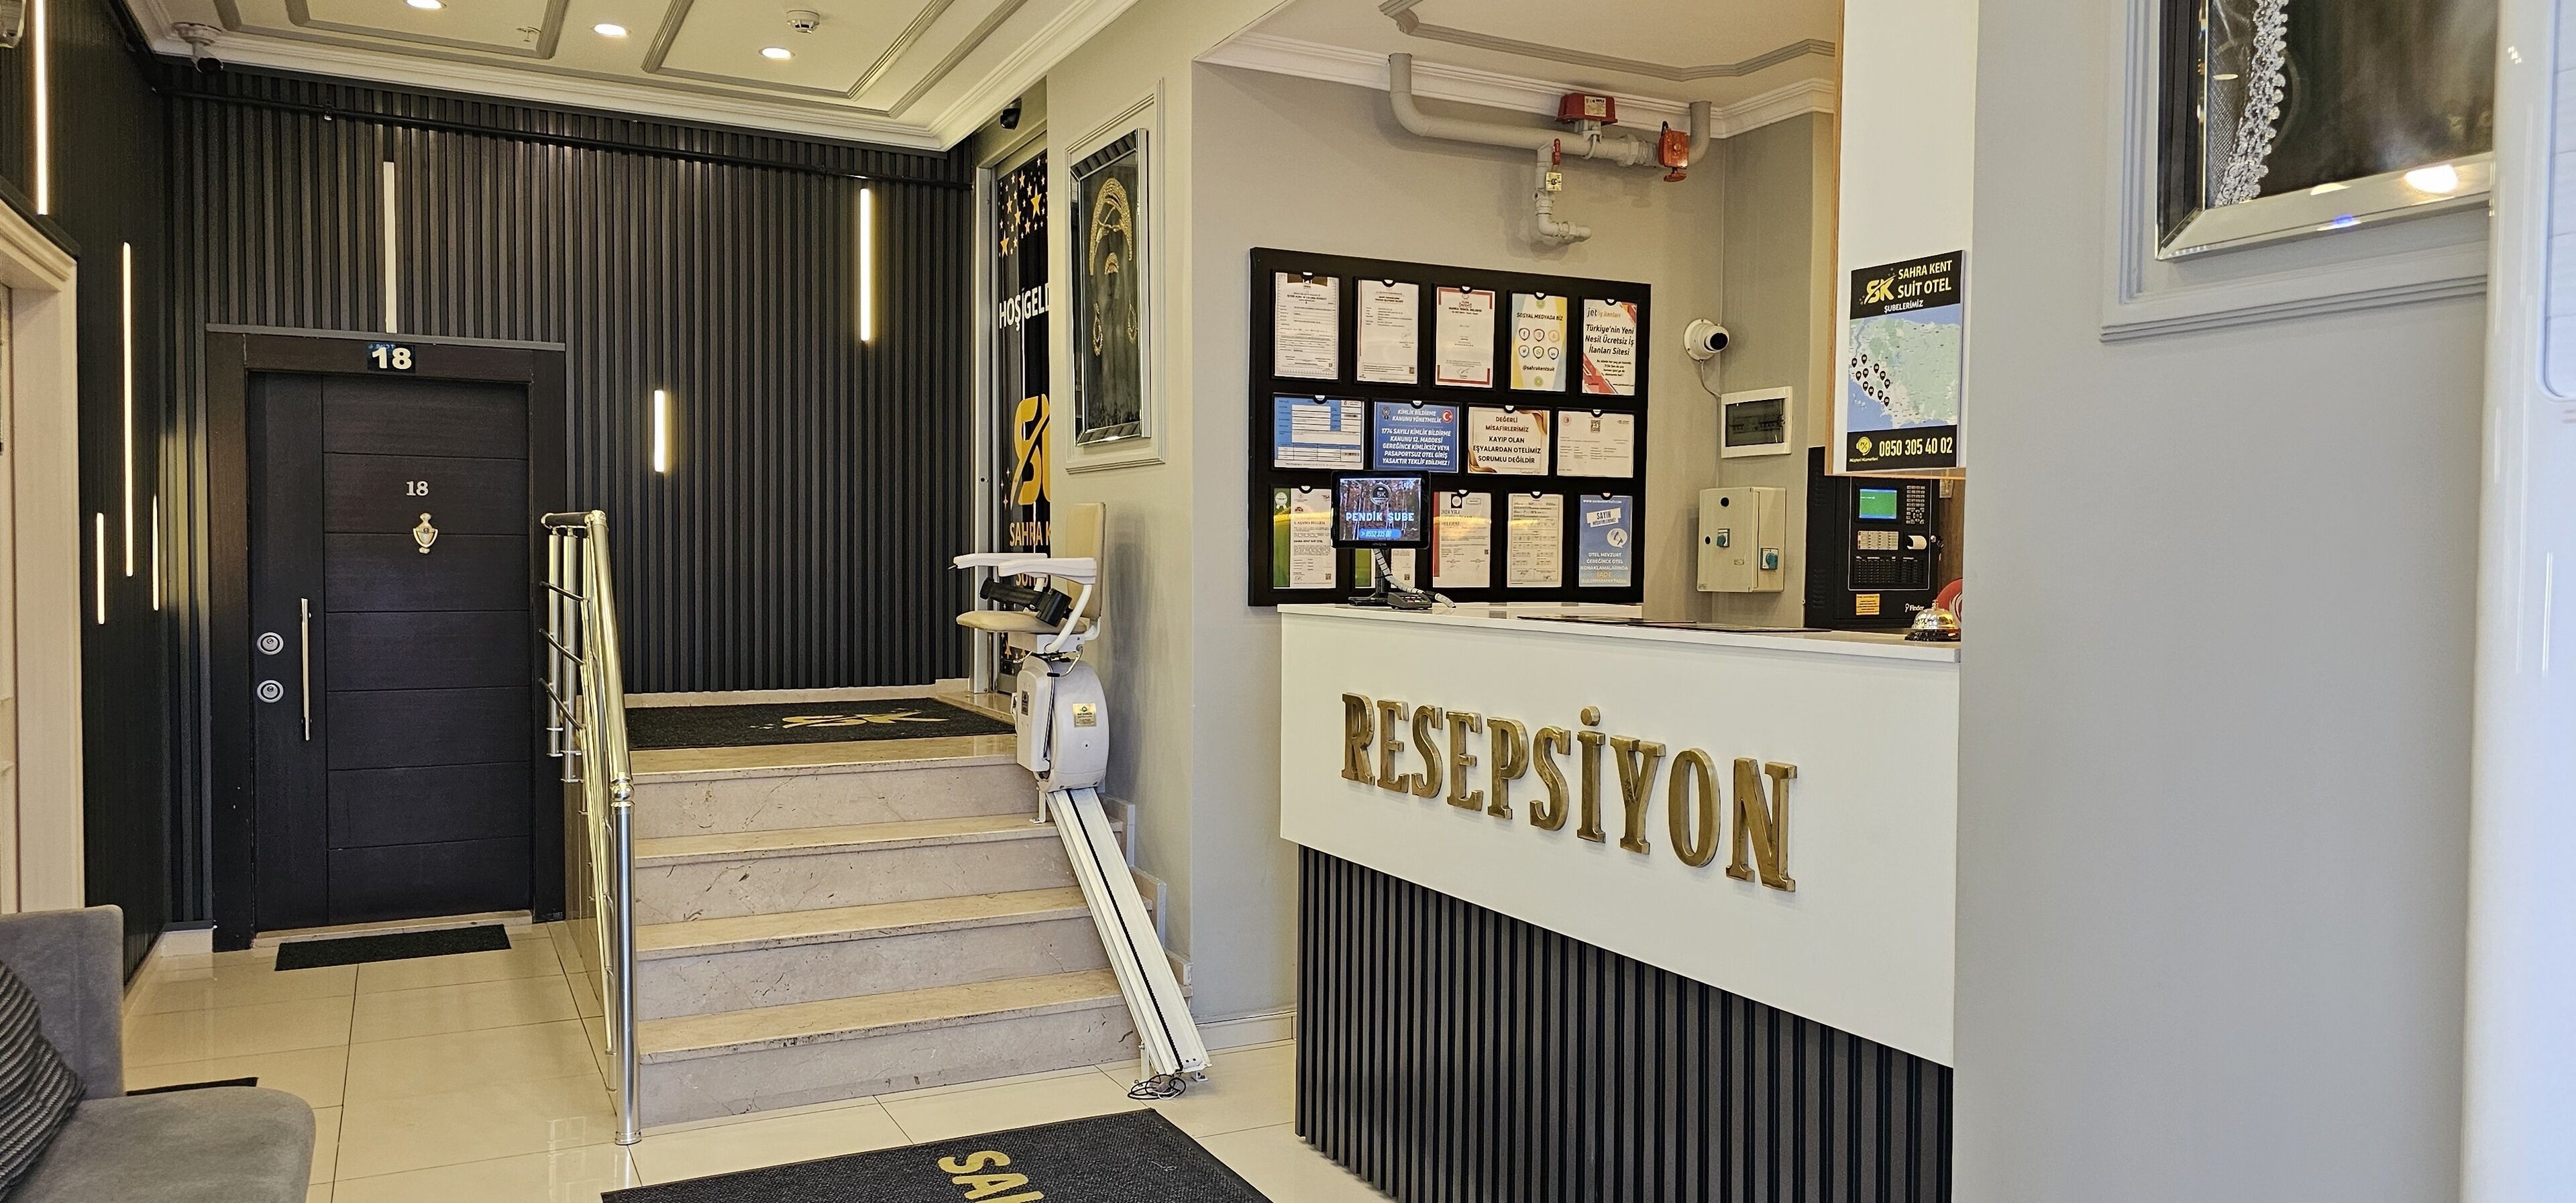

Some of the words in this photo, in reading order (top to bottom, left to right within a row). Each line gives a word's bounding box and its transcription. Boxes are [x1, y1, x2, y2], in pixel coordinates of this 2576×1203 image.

[1898, 265, 1927, 280] SAHRA
[1929, 260, 1953, 274] KENT
[1864, 275, 1896, 305] SK
[1898, 280, 1922, 299] SUİT
[1924, 277, 1951, 294] OTEL
[1587, 307, 1597, 317] jet
[1884, 299, 1924, 313] ŞUBELERİMİZ
[1587, 324, 1620, 334] Türkiye'nin
[1585, 335, 1601, 343] Nesil
[1603, 335, 1627, 345] Ücretsiz
[1629, 335, 1634, 347] İş
[1589, 344, 1611, 354] İlanları
[1613, 348, 1630, 356] Sitesi
[372, 348, 412, 369] 18
[1485, 424, 1529, 432] MİSAFİRLERİMİZ
[1513, 446, 1542, 454] OTELİMİZ
[1879, 439, 1902, 457] 0850
[1904, 438, 1923, 456] 305
[1925, 437, 1938, 454] 40
[1940, 437, 1953, 454] 02
[407, 480, 429, 496] 18
[1346, 511, 1383, 521] PENDİK
[1597, 511, 1611, 520] SAYIN
[1010, 521, 1043, 546] SAHRA
[1342, 692, 1798, 892] RESEPSİYON
